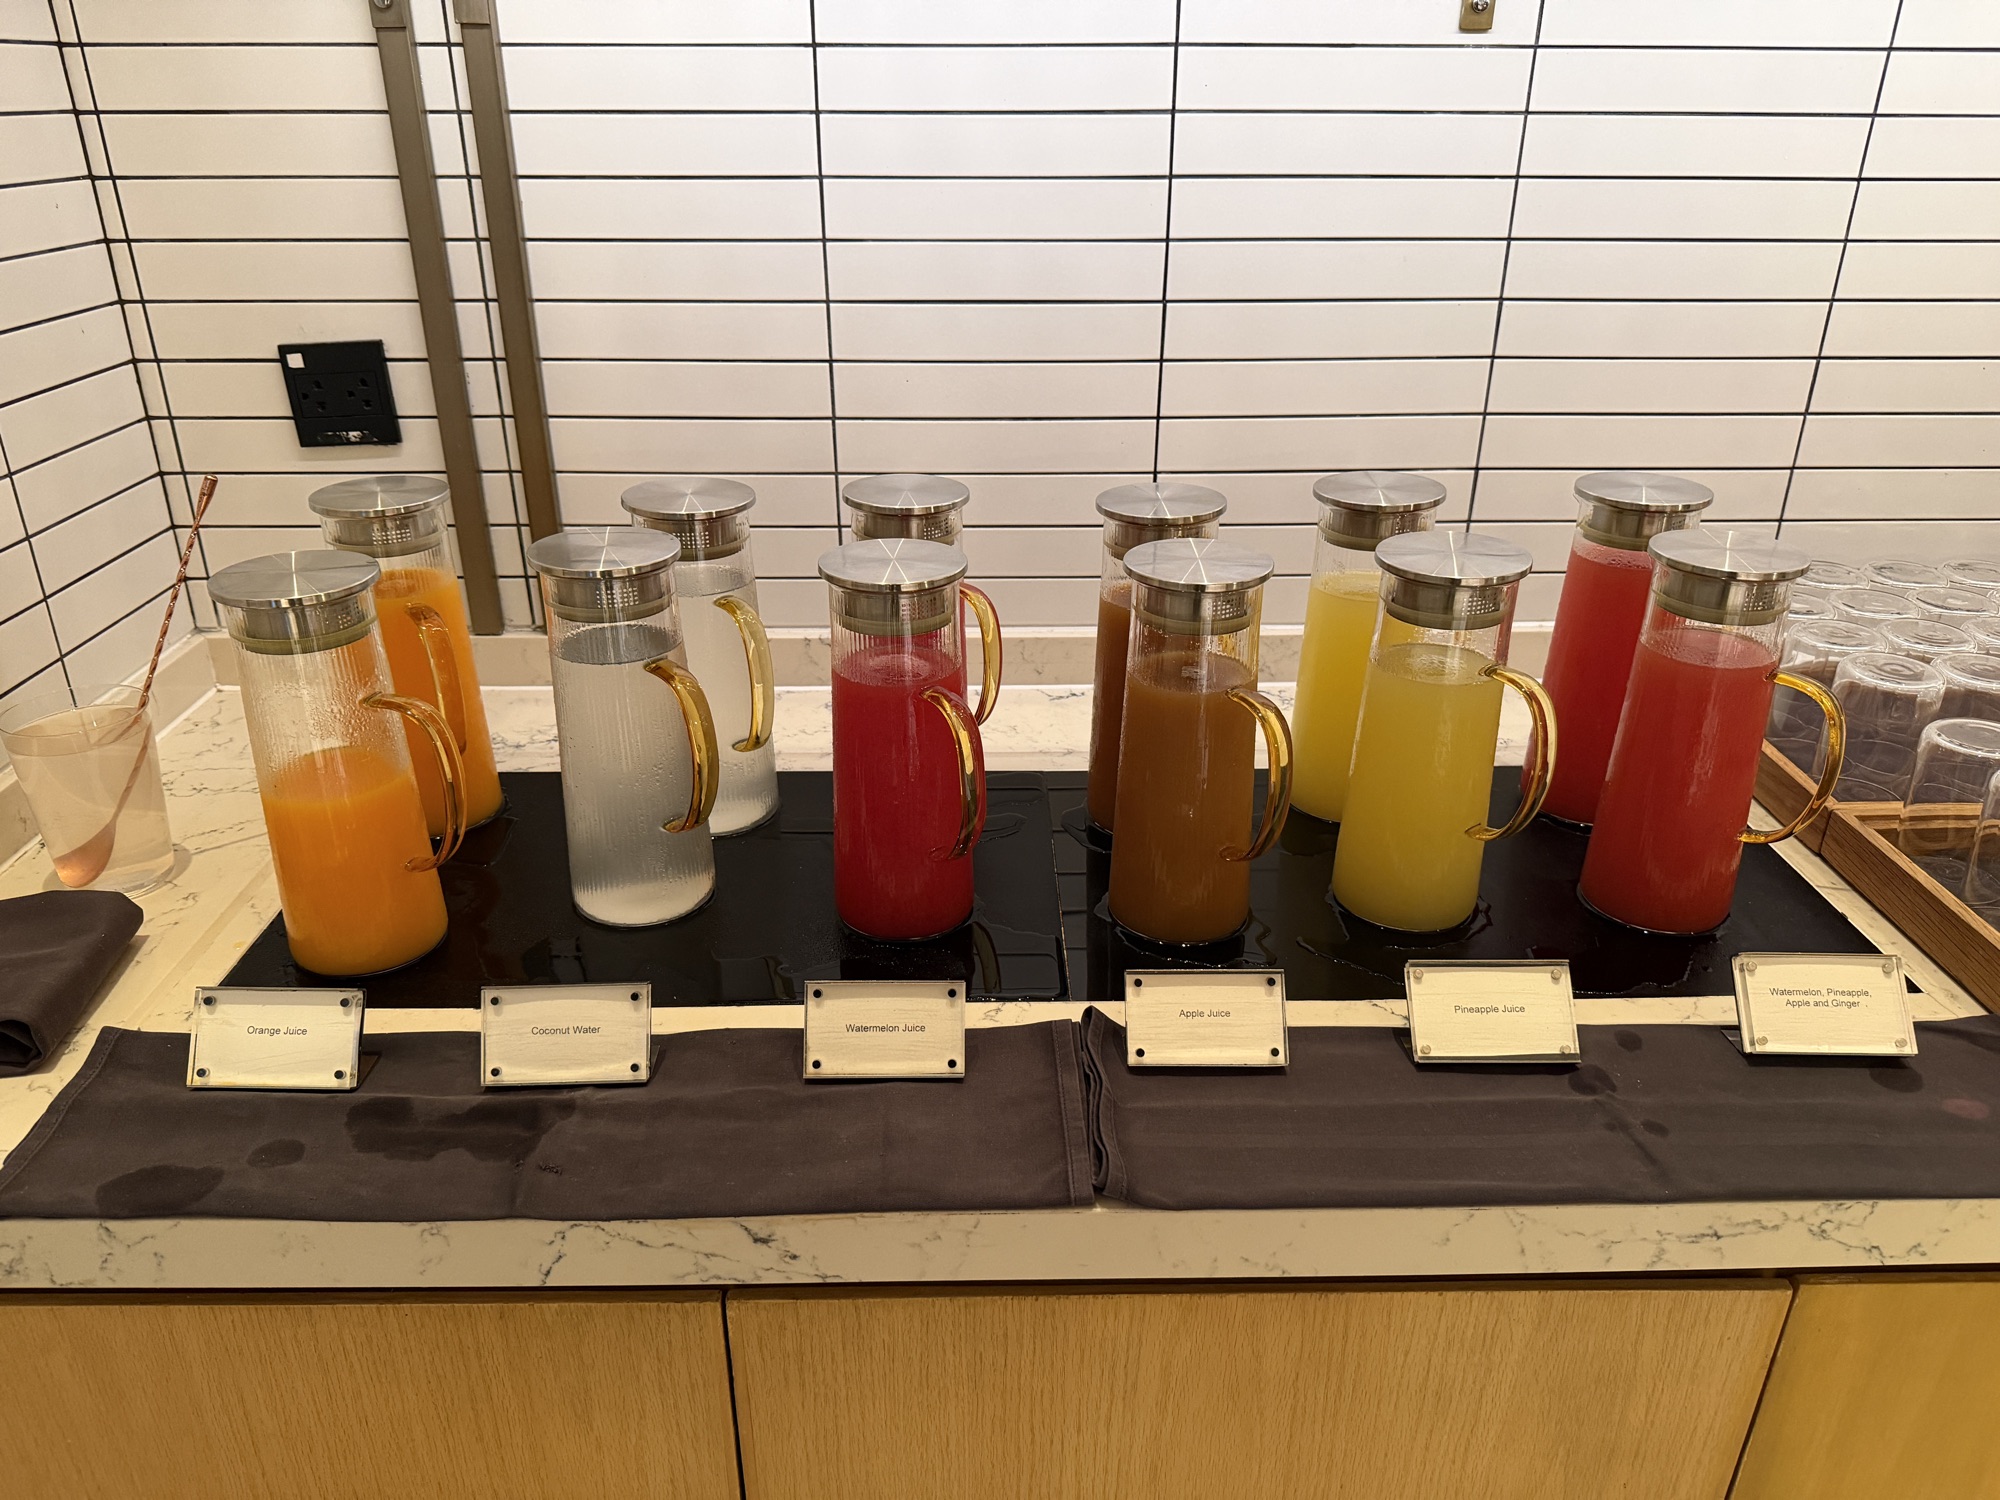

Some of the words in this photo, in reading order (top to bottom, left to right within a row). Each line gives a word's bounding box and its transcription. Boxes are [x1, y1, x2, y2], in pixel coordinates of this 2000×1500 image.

[1768, 987, 1825, 998] Watermelon,
[1826, 987, 1872, 999] Pineapple,
[1453, 1004, 1500, 1015] Pineapple
[1501, 1004, 1526, 1013] Juice
[1785, 999, 1811, 1009] Apple
[1813, 999, 1830, 1008] and
[1831, 999, 1861, 1010] Ginger
[1178, 1009, 1205, 1020] Apple
[1206, 1009, 1231, 1018] Juice
[246, 1025, 282, 1037] Orange
[283, 1025, 308, 1036] Juice
[531, 1026, 571, 1036] Coconut
[572, 1025, 601, 1035] Water
[845, 1023, 900, 1033] Watermelon
[901, 1023, 926, 1033] Juice
